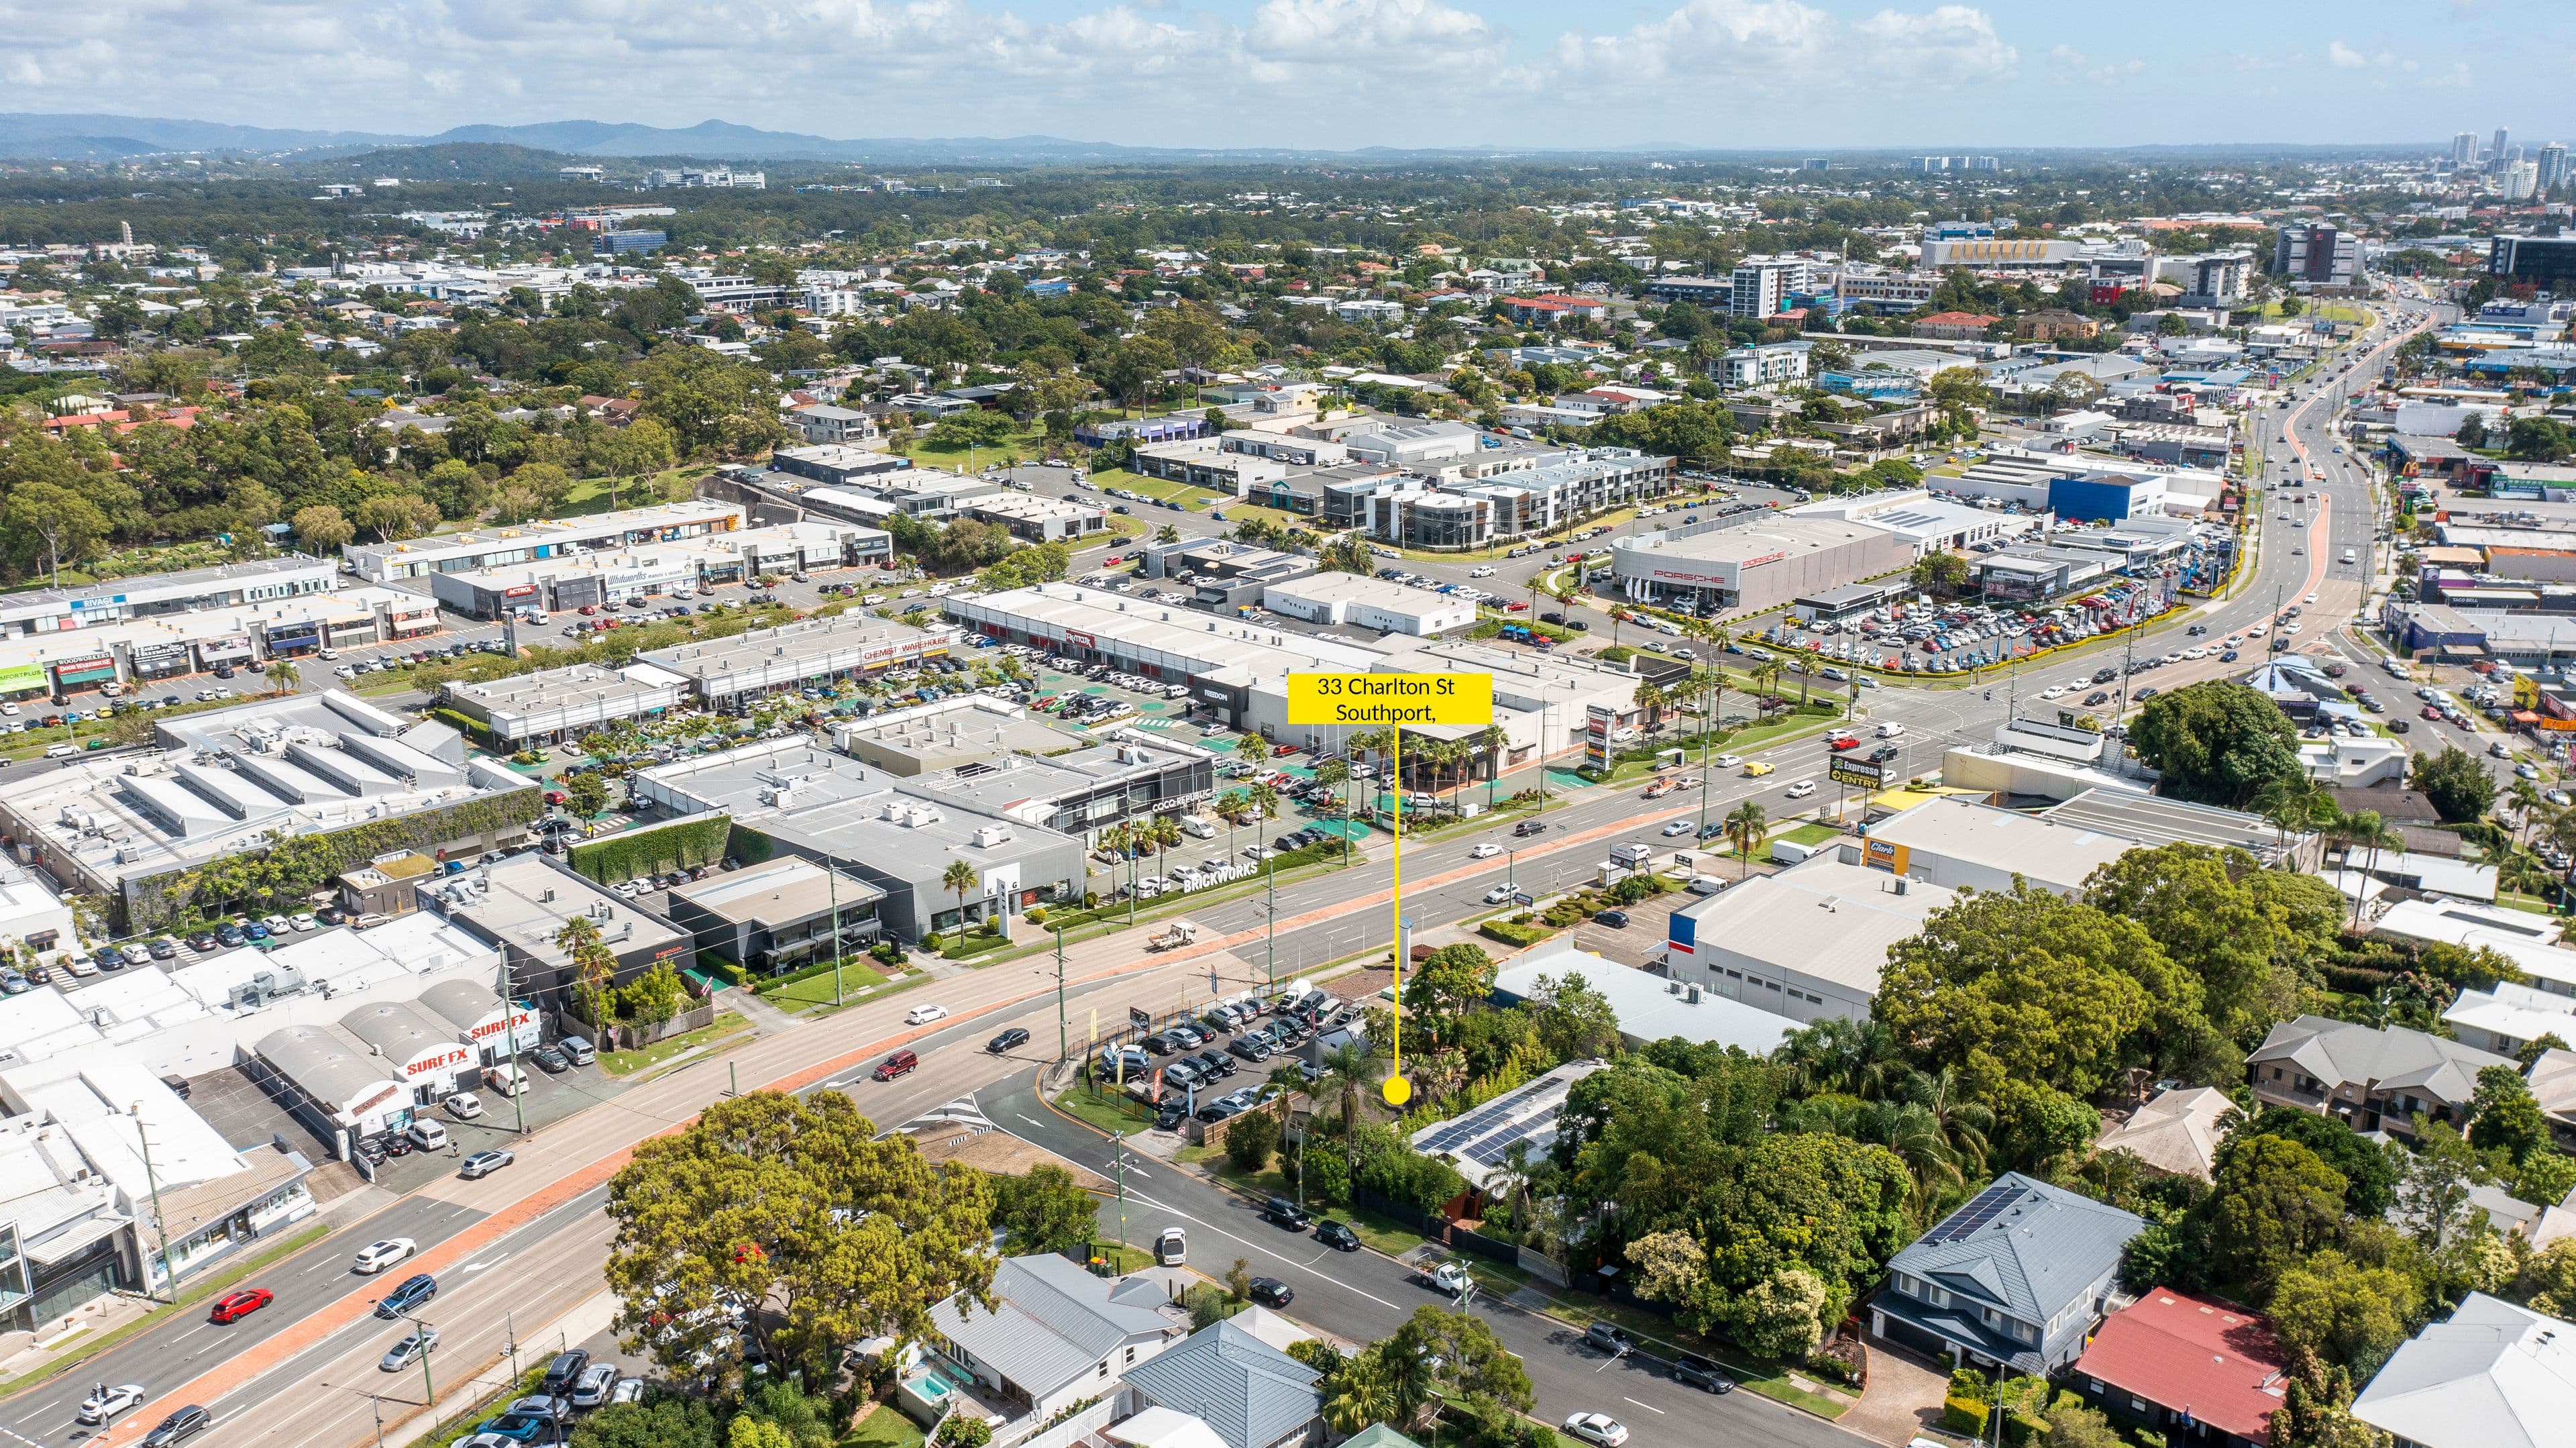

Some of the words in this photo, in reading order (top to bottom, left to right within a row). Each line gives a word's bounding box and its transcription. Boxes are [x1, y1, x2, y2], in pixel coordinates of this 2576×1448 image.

[1743, 551, 1786, 567] PORSCHE
[608, 571, 647, 585] Whitworths
[1654, 570, 1725, 584] PORSCHE
[508, 586, 533, 595] ACTROL
[84, 597, 114, 607] RIVAGE
[865, 647, 897, 660] CHEMIST
[902, 636, 949, 652] WAREHOUSE
[58, 652, 109, 665] WOODWORKERS
[76, 660, 111, 670] WAREHOUSE
[1204, 689, 1228, 701] FREEDOM
[1844, 761, 1878, 776] Expresso
[1842, 775, 1878, 788] ENTRY
[1152, 799, 1175, 812] COCO
[1177, 789, 1210, 805] REPUBLIC
[1871, 842, 1893, 854] Clark
[1872, 851, 1892, 862] RUBBER
[1183, 861, 1258, 894] BRICKWORKS
[987, 882, 1017, 895] KG
[472, 1019, 508, 1039] SURF
[511, 1013, 529, 1027] FX
[407, 1054, 445, 1075] SURF
[448, 1048, 468, 1063] FX
